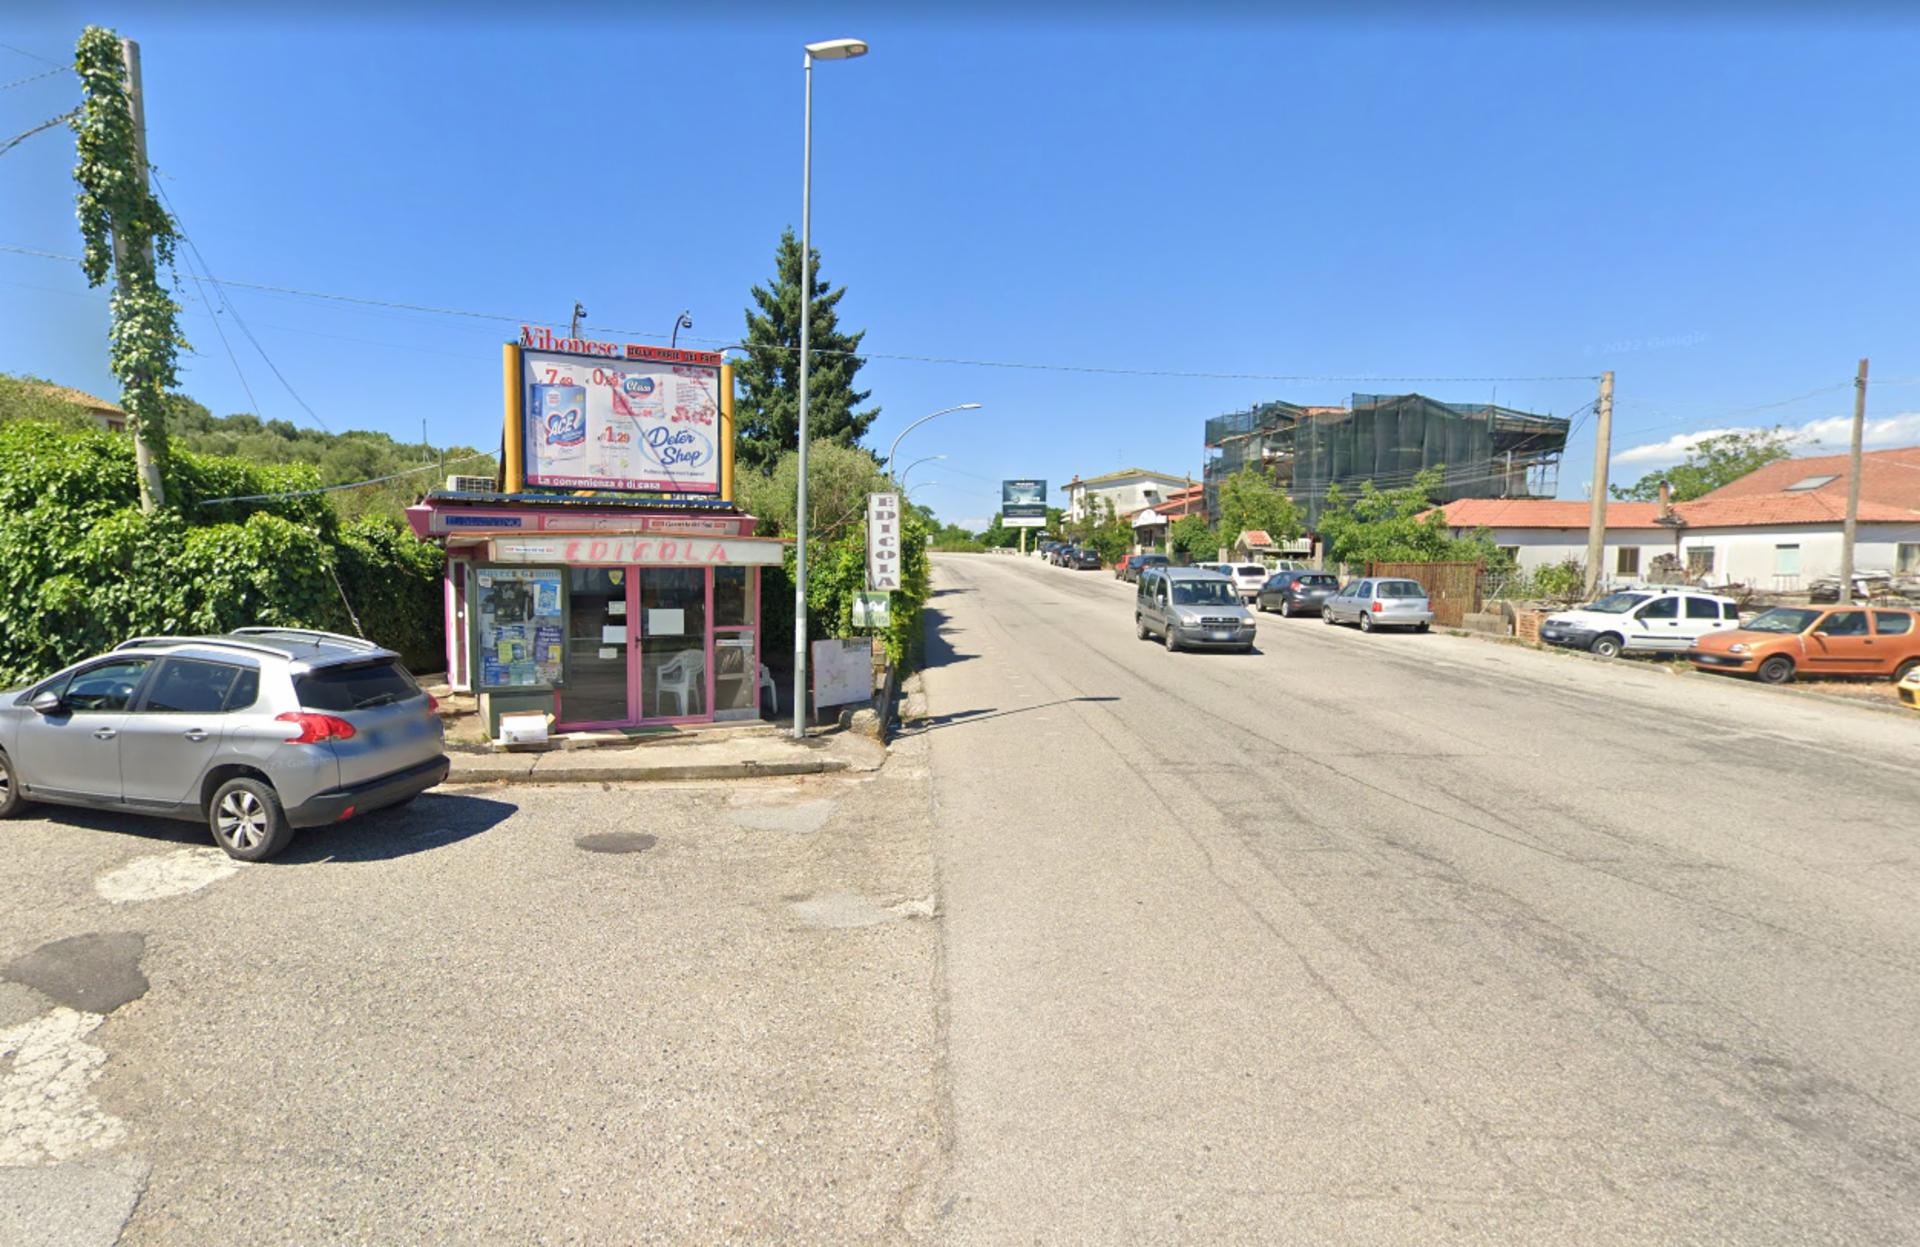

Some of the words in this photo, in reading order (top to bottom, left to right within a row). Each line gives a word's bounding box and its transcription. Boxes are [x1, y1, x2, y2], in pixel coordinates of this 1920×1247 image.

[521, 325, 618, 356] Vibonese
[551, 413, 576, 434] ACE
[648, 426, 696, 449] Deter
[660, 446, 703, 467] Shop
[538, 477, 550, 485] La
[553, 479, 615, 488] convenienza
[626, 480, 636, 489] di
[639, 482, 661, 490] casa
[565, 540, 728, 562] EDICOLA
[874, 496, 897, 587] EDICOLA
